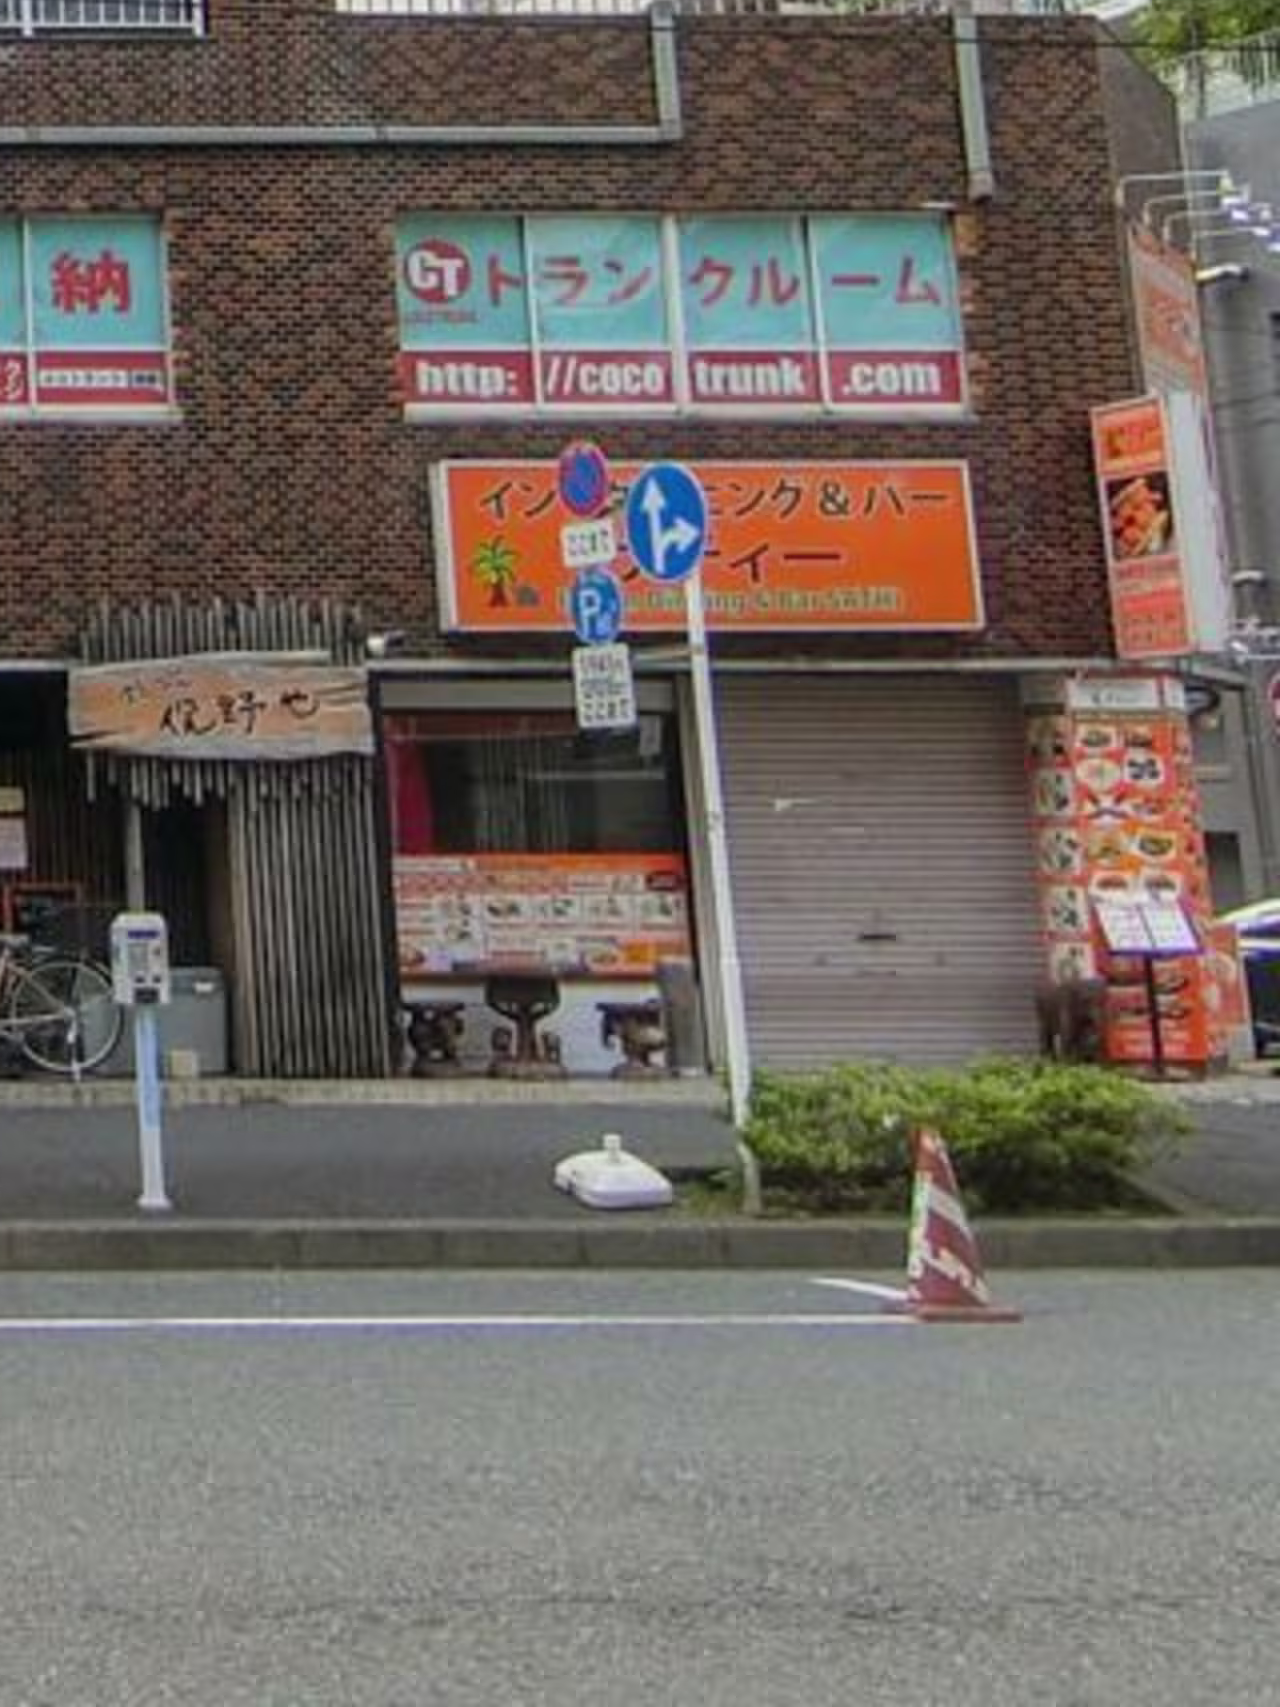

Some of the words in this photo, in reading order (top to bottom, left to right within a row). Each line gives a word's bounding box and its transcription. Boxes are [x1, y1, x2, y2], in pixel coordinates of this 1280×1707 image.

[486, 252, 942, 308] トランクルーム
